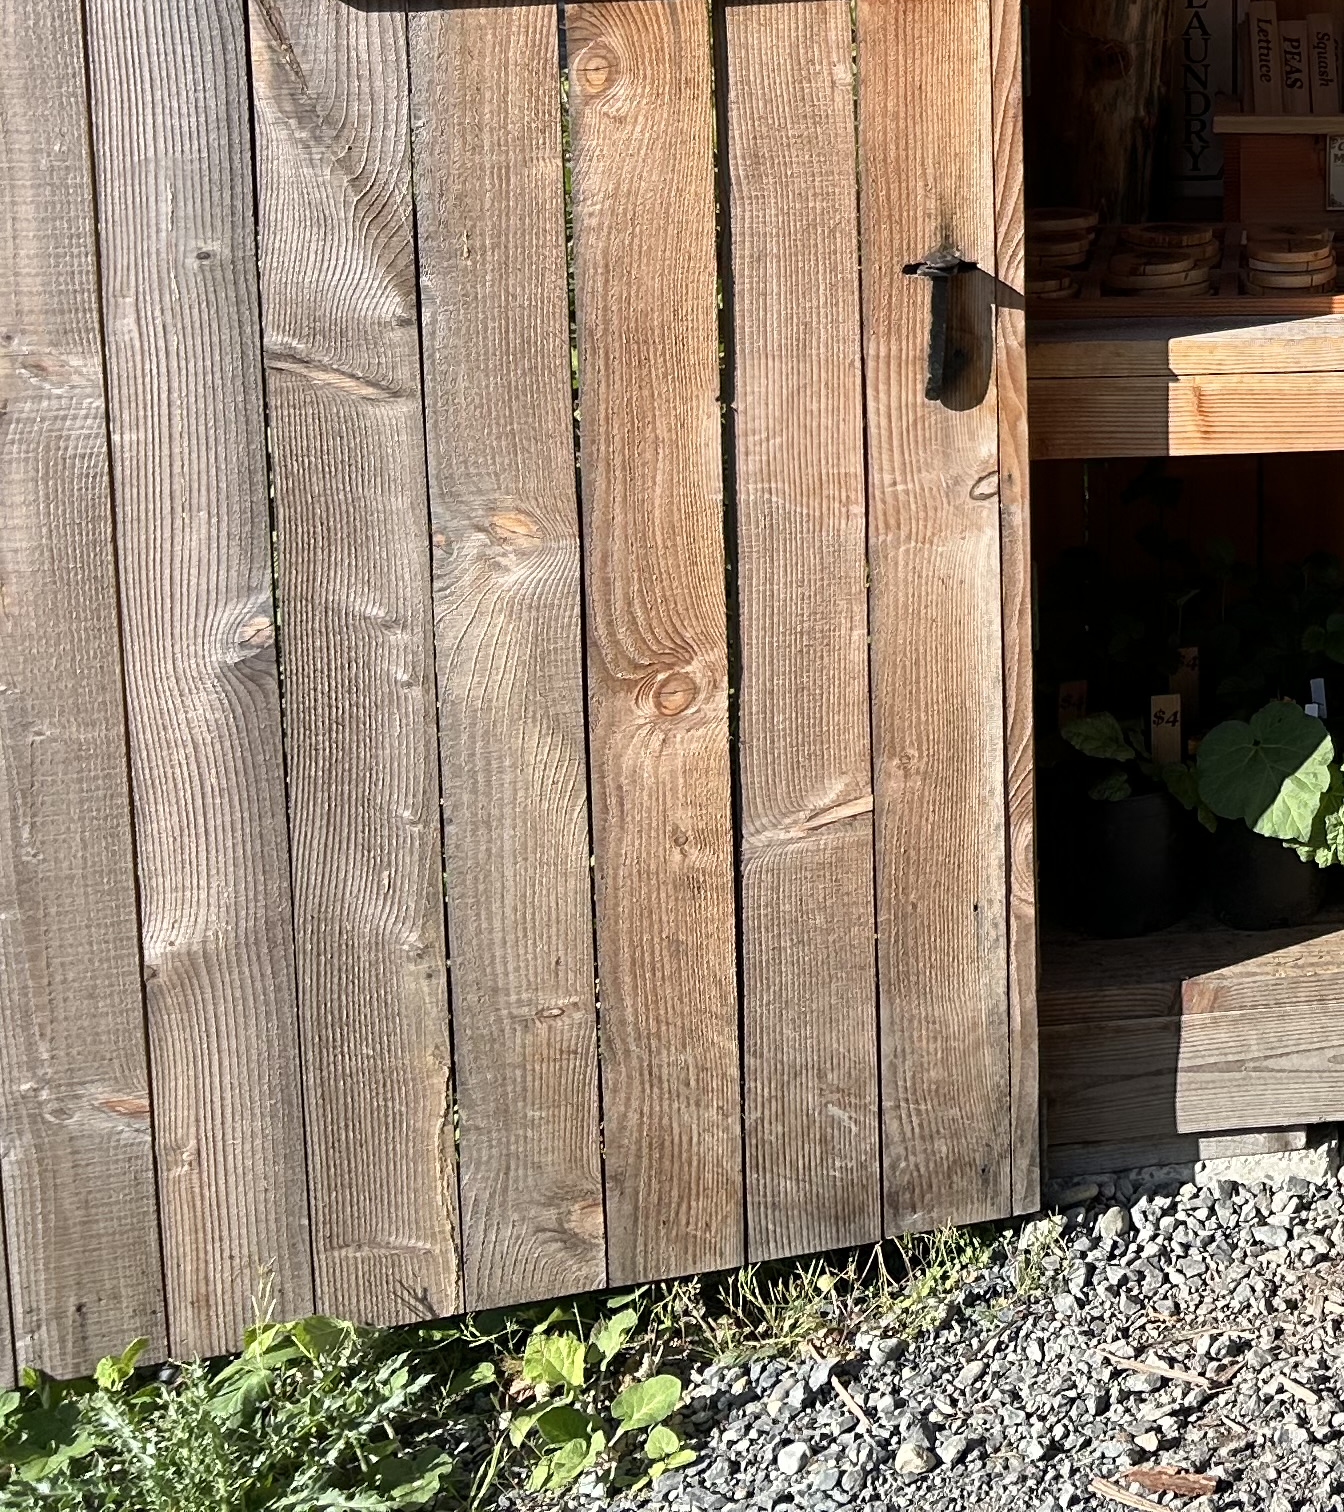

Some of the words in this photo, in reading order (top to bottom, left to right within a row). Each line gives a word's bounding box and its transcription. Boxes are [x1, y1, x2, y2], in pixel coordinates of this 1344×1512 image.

[1256, 17, 1273, 84] Lettuce
[1282, 36, 1304, 90] PEAS
[1312, 31, 1335, 87] Squash
[1152, 708, 1179, 728] $4
